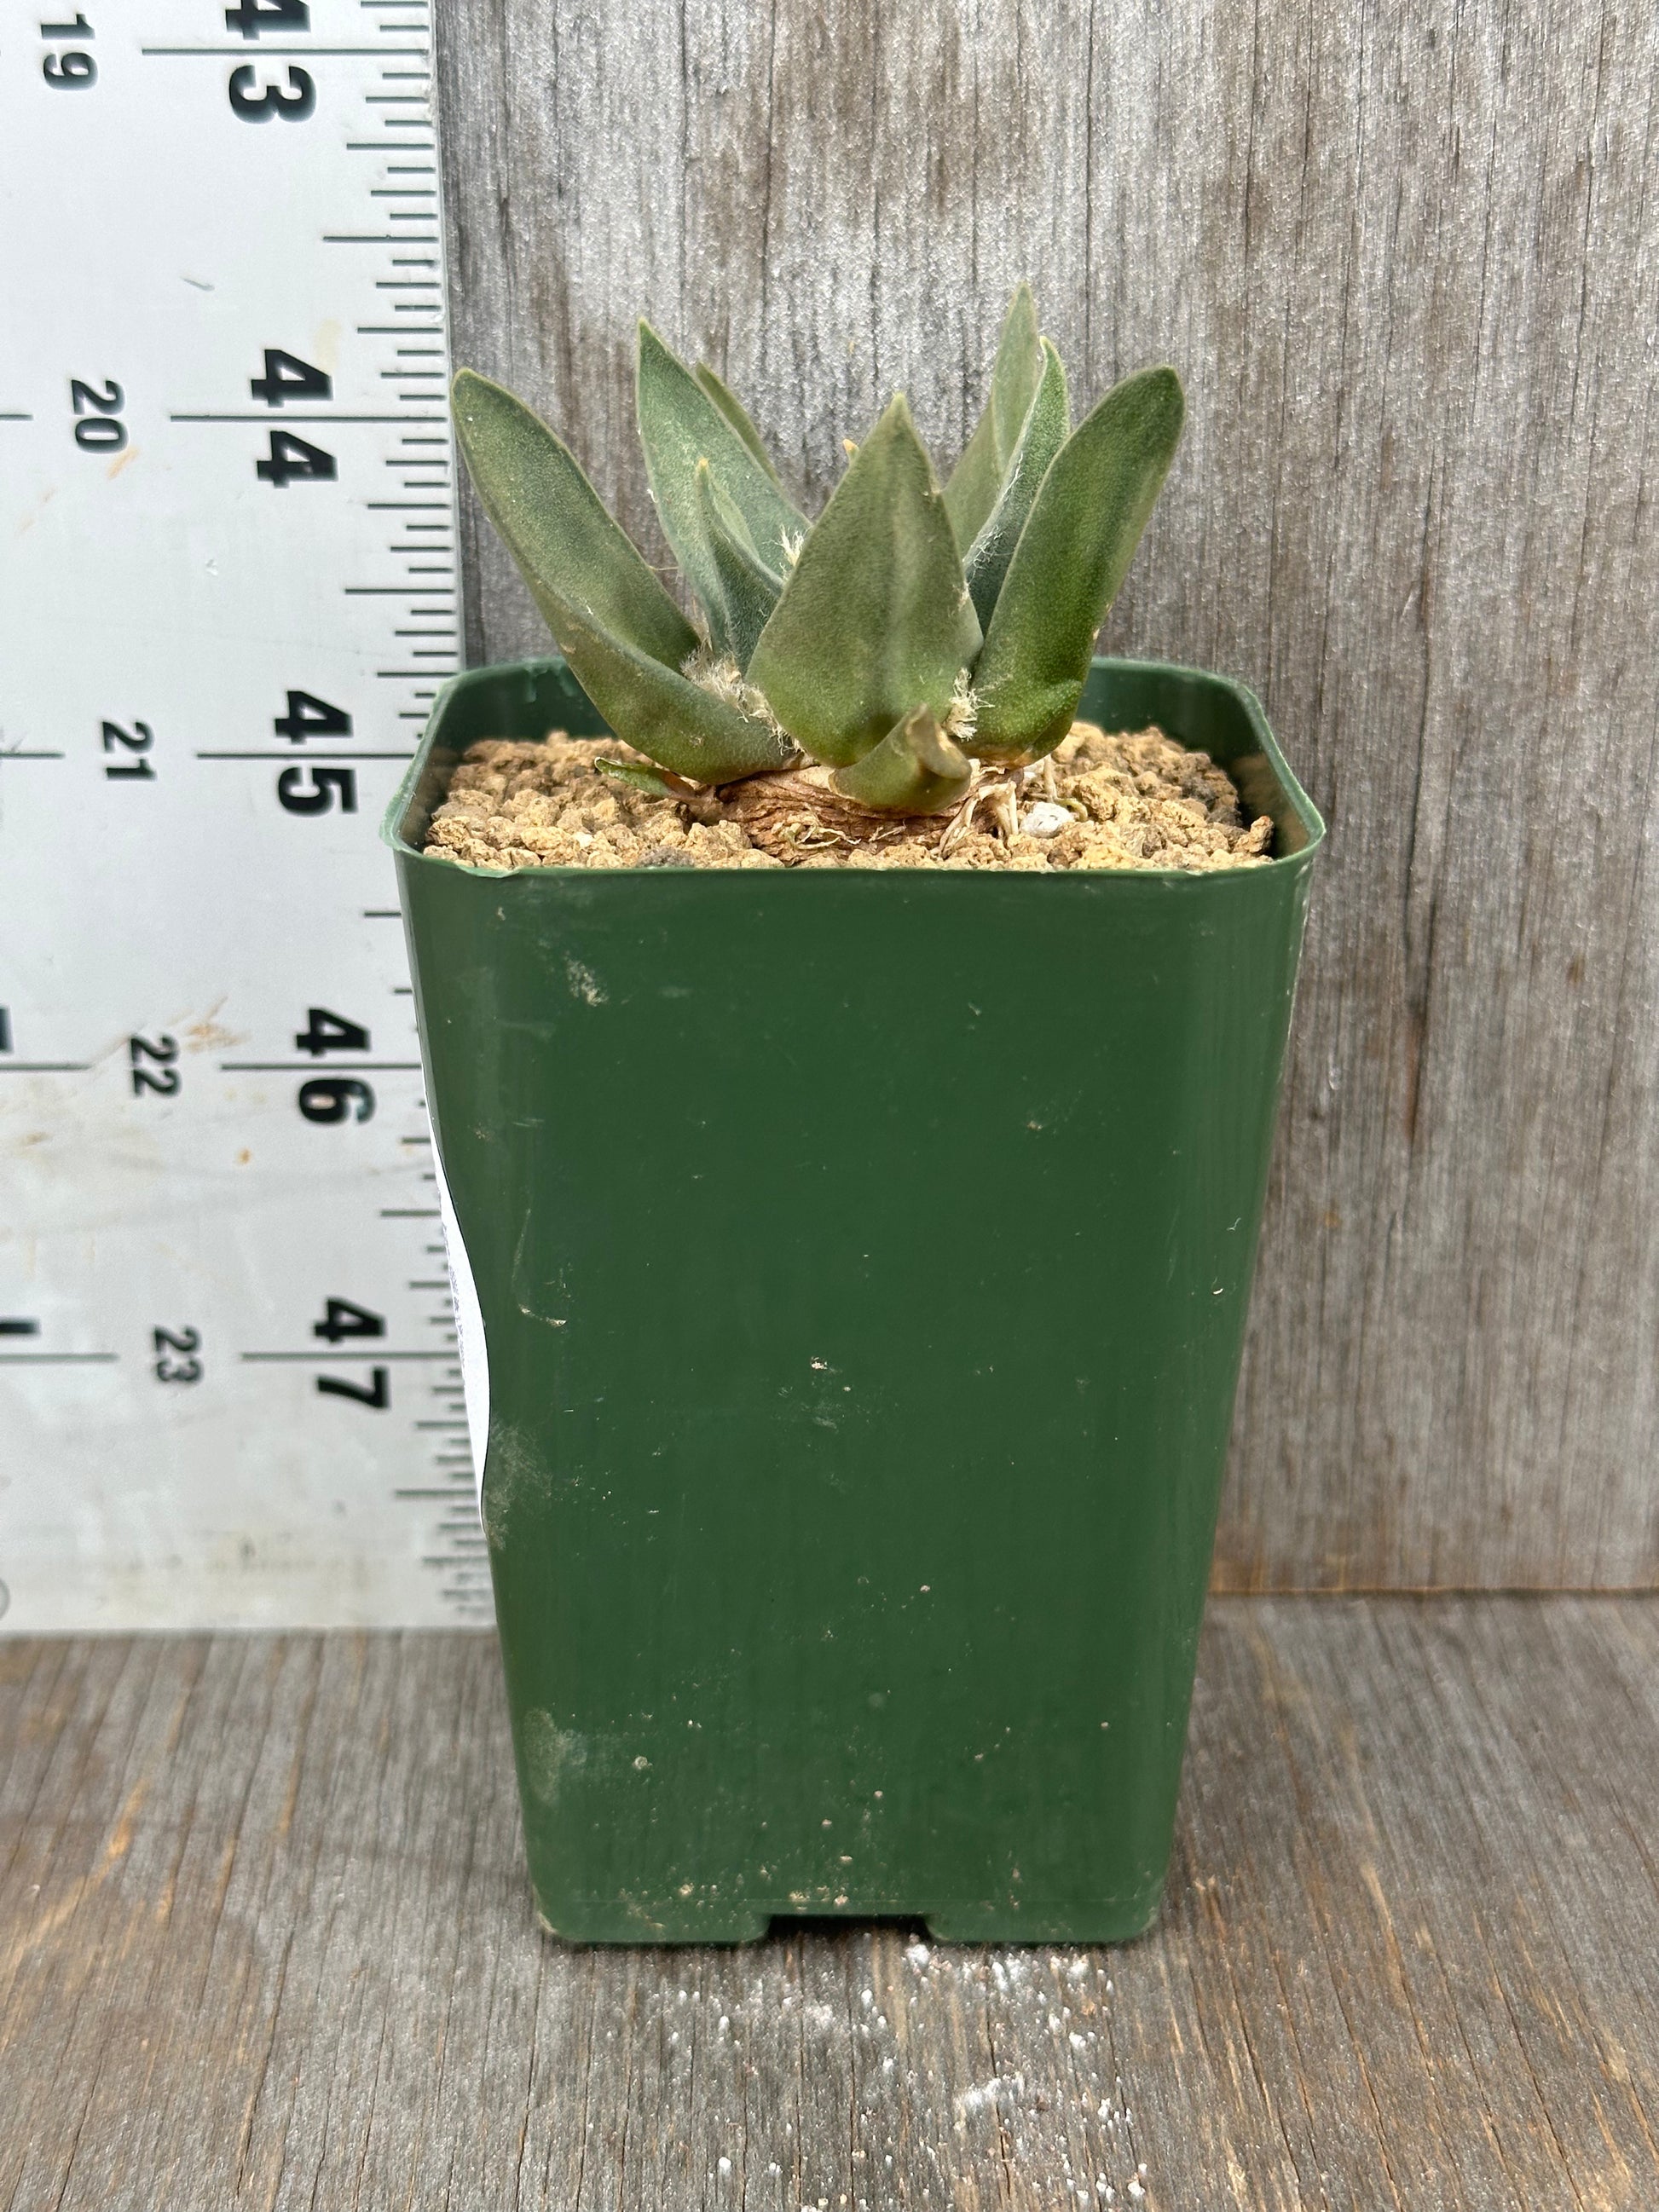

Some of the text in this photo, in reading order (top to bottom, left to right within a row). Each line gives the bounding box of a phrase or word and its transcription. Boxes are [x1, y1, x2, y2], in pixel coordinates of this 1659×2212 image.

[40, 13, 98, 90] 19
[70, 378, 128, 454] 20
[250, 348, 338, 488] 44
[101, 720, 157, 782] 21
[273, 690, 358, 816] 45
[128, 1035, 181, 1098] 22
[294, 1007, 376, 1127] 46
[152, 1325, 204, 1385] 23
[312, 1296, 390, 1412] 47
